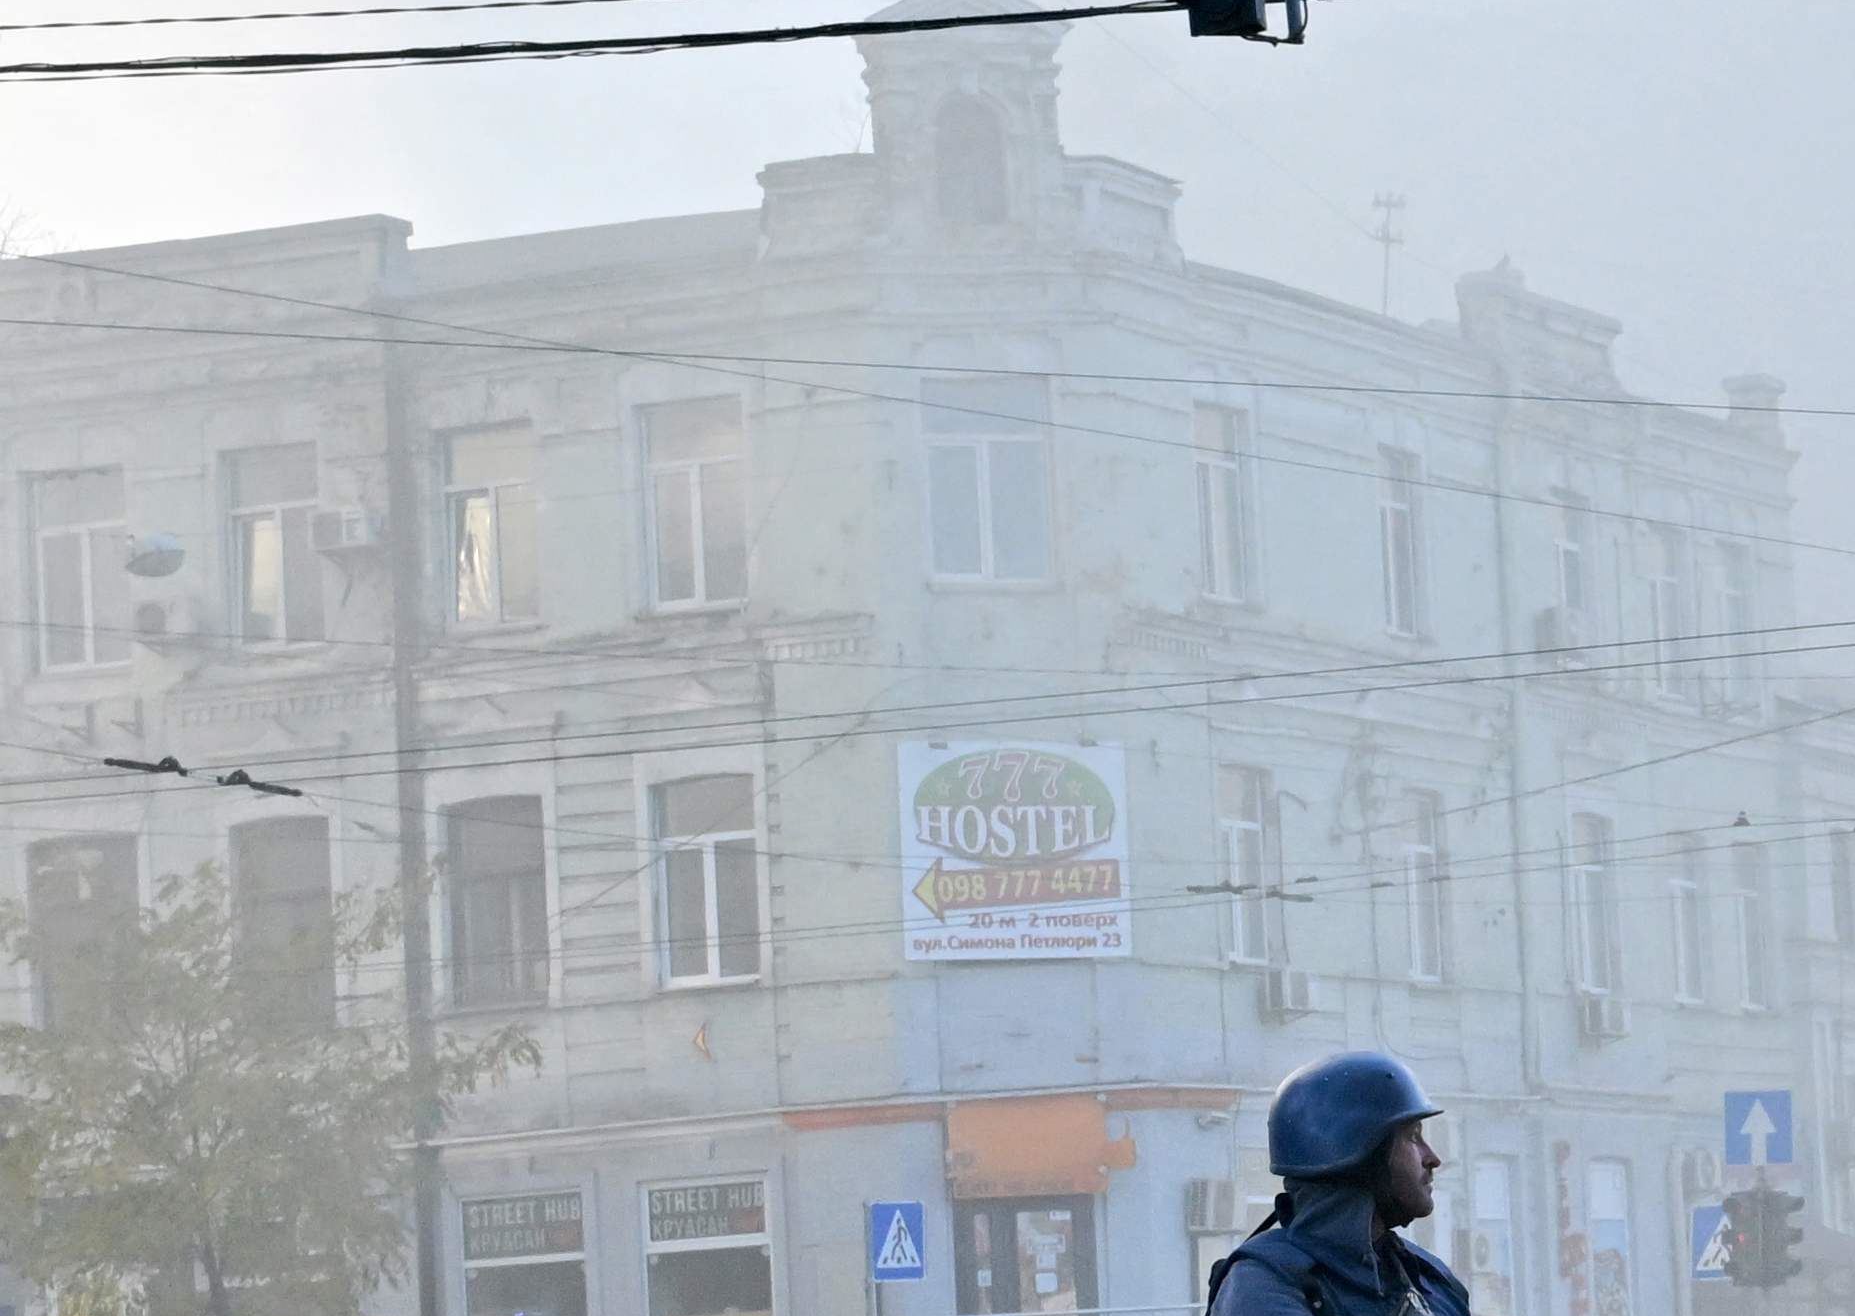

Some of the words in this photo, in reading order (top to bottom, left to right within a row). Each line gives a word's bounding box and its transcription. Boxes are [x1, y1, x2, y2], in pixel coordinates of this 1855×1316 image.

[958, 751, 1065, 802] 777
[916, 805, 1111, 857] HOSTEL
[937, 874, 988, 902] 098
[994, 869, 1043, 898] 777
[1050, 865, 1113, 894] 4477
[1046, 913, 1119, 931] поверх
[1020, 934, 1098, 951] Петлюри
[1102, 932, 1122, 948] 23
[469, 1201, 536, 1228] STREET
[545, 1196, 580, 1222] HUB
[651, 1188, 720, 1214] STREET
